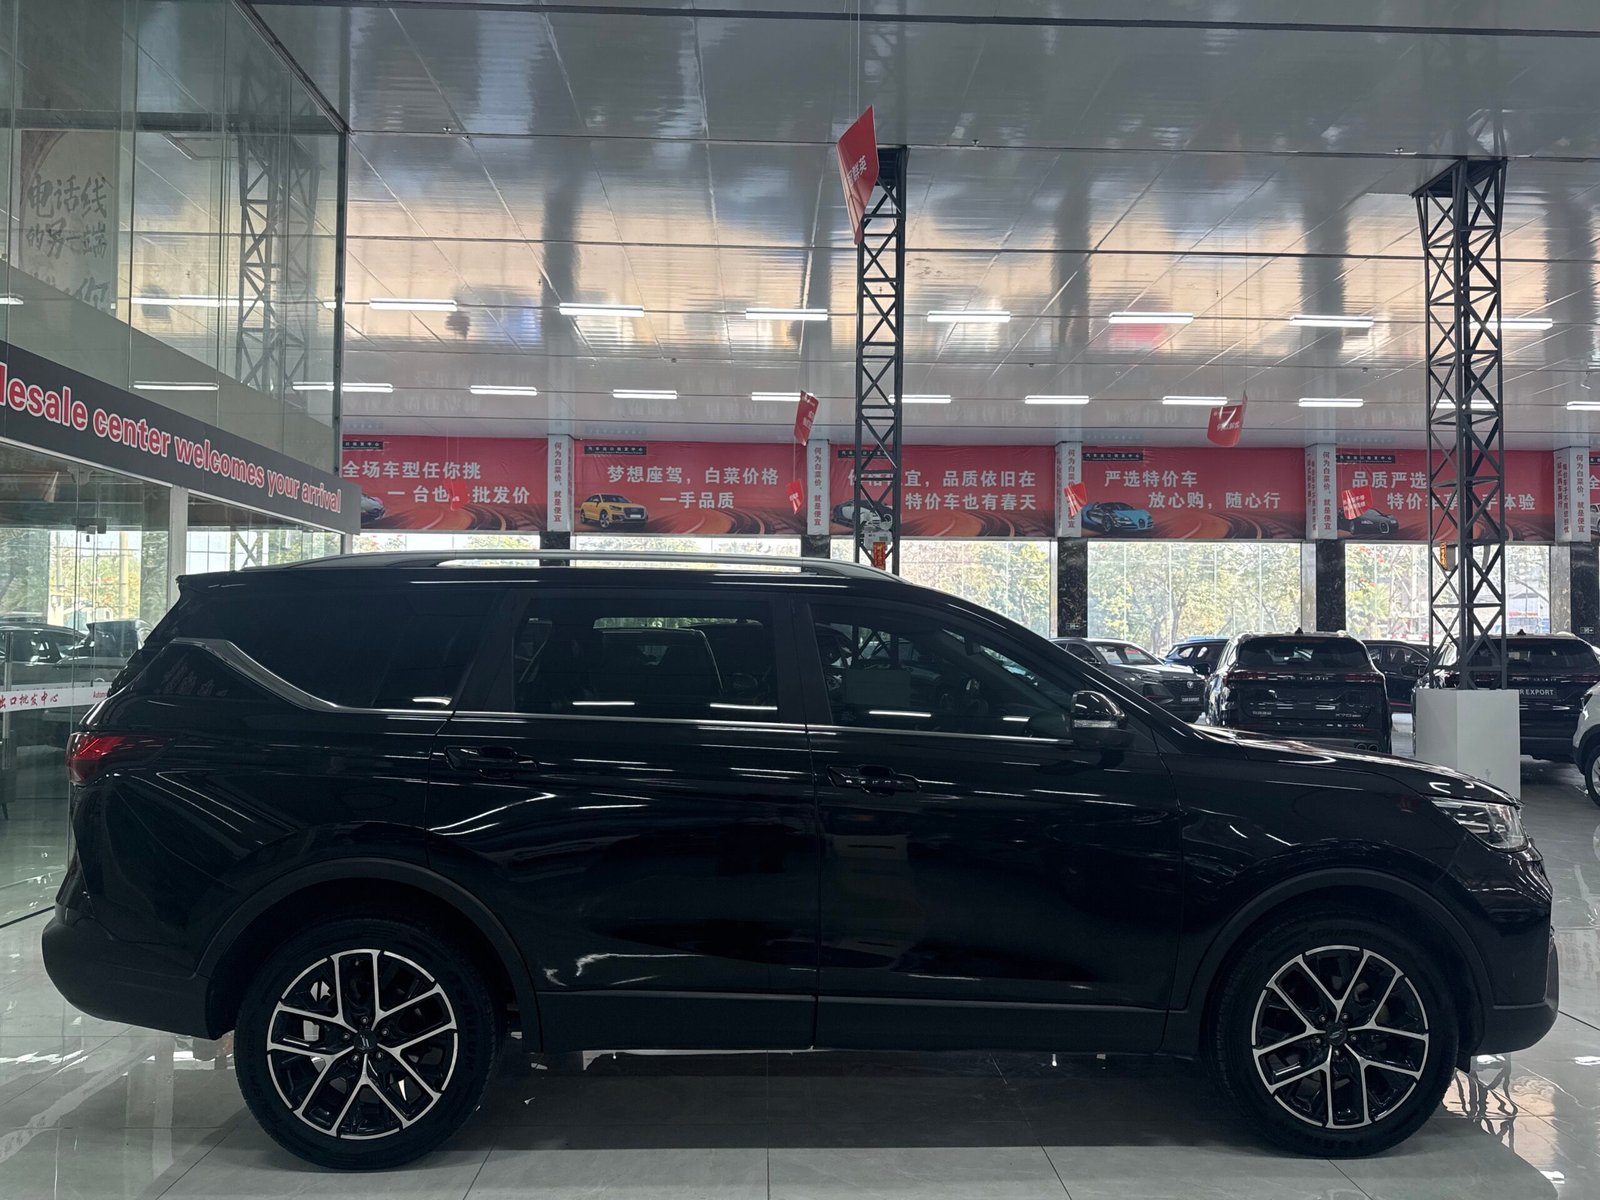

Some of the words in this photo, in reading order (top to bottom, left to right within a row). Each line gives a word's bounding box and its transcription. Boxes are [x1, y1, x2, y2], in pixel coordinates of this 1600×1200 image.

[27, 174, 108, 218] 电话线
[26, 217, 108, 259] 的另一端
[92, 406, 171, 458] center
[173, 434, 265, 489] welcomes
[266, 468, 300, 500] your
[301, 482, 342, 514] arrival
[342, 460, 481, 480] 全场车型任你挑
[607, 465, 779, 486] 梦想座驾，白菜价格
[1104, 470, 1198, 488] 严选特价车
[1352, 471, 1427, 489] 品质严选
[387, 485, 530, 505] 一台也批发价
[659, 491, 735, 509] 一手品质
[905, 493, 1037, 511] 特价车也有春天
[1148, 491, 1281, 510] 放心购，随心行
[1525, 688, 1554, 696] EXPORT
